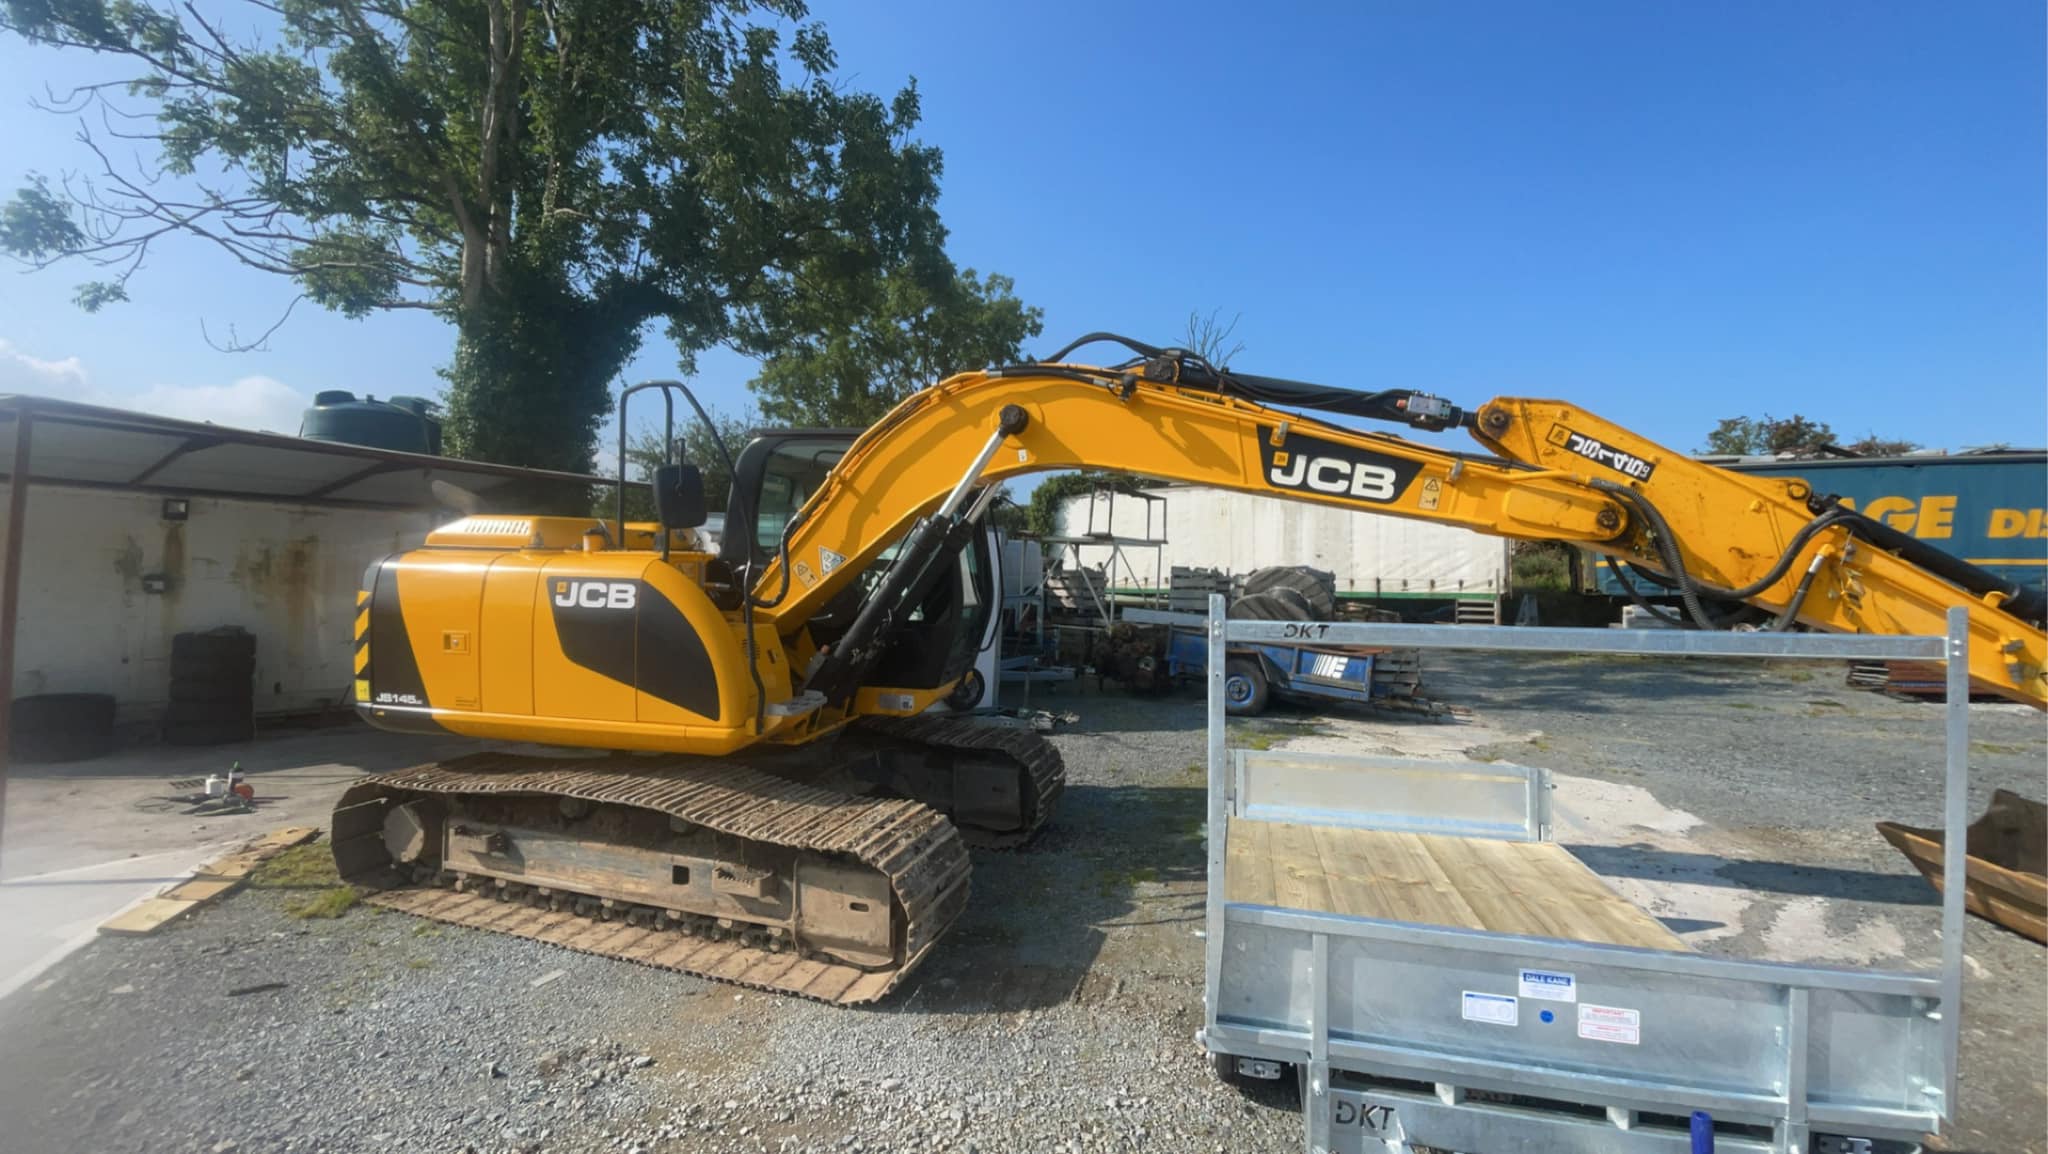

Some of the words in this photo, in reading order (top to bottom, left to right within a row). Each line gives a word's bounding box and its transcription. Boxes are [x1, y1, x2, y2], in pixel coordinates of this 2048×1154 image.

[1270, 454, 1397, 500] JCB
[1838, 495, 1958, 539] GE
[555, 581, 636, 609] JCB
[1283, 623, 1330, 639] DKT
[1335, 1100, 1395, 1130] DKT
